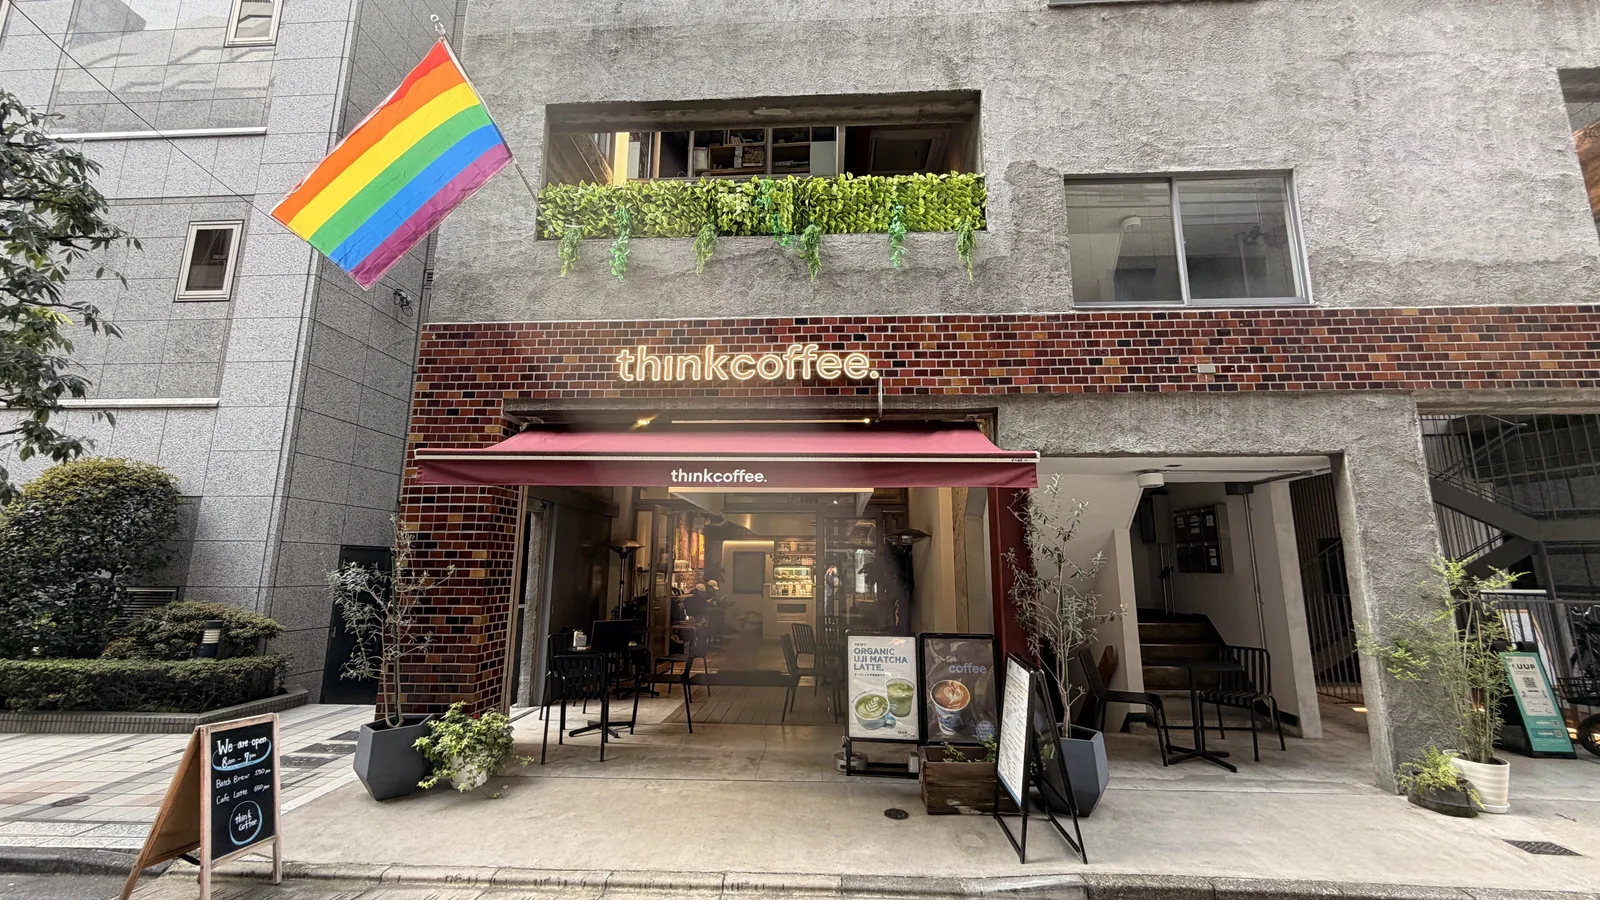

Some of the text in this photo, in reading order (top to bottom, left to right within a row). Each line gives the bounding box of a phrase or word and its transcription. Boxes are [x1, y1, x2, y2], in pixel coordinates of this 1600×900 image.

[616, 343, 880, 381] thinkcoffee.
[671, 468, 768, 483] thinkcoffee.
[853, 647, 896, 656] ORGANIC
[853, 655, 909, 664] UJI MATCHA
[853, 663, 885, 671] LATTE.
[948, 662, 988, 674] coffee
[217, 737, 267, 755] We are open
[216, 777, 231, 789] Batch
[233, 774, 250, 783] Brew
[233, 789, 248, 798] Latte
